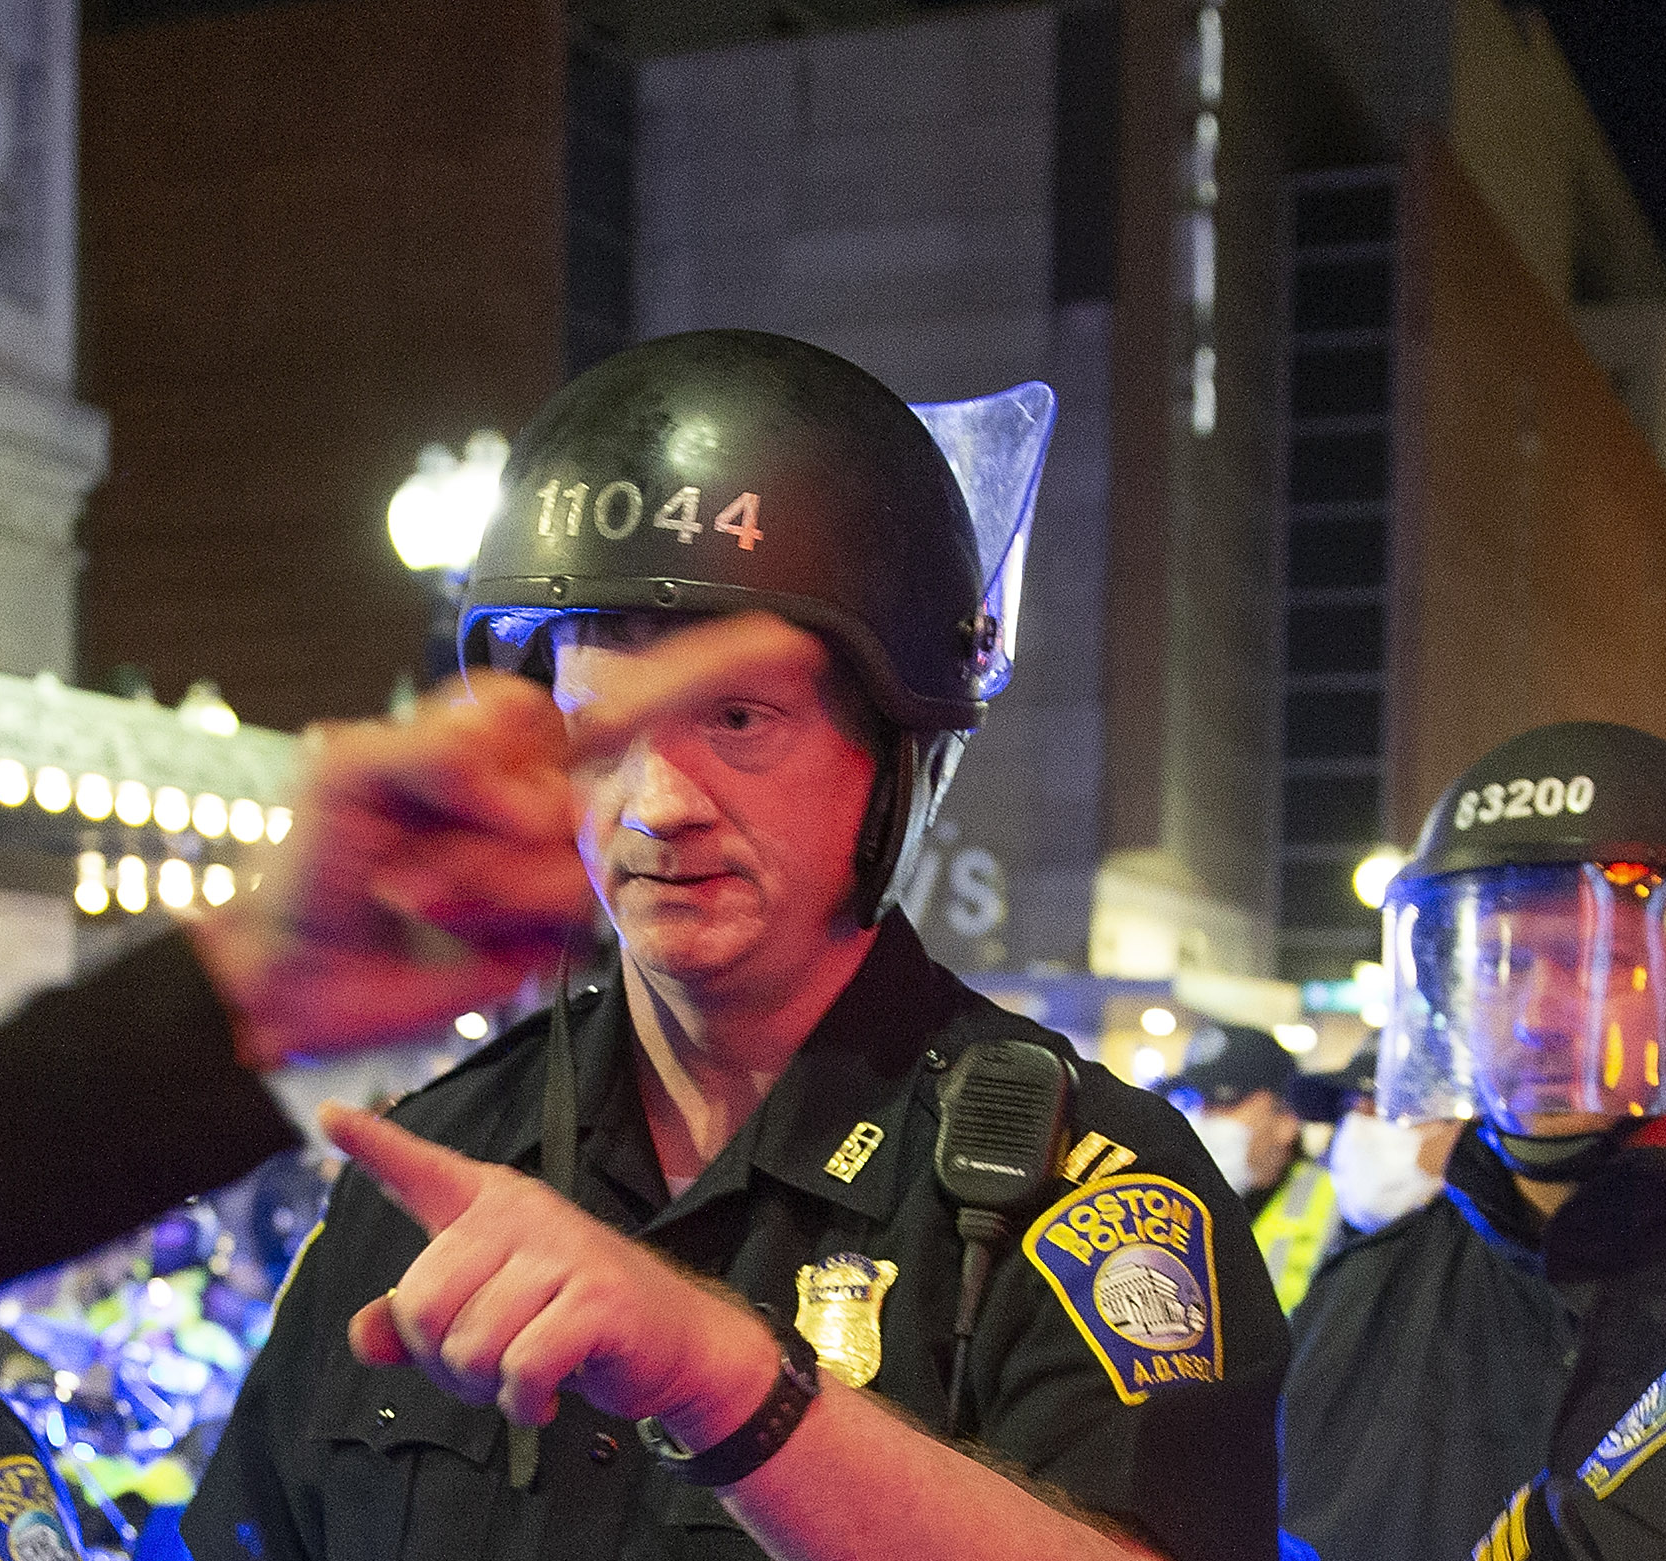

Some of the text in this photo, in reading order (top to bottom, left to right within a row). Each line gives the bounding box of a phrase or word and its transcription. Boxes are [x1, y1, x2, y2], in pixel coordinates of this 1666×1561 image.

[536, 477, 765, 551] 11044
[1044, 1189, 1193, 1249] BOSTON
[1065, 1216, 1191, 1266] POLICE
